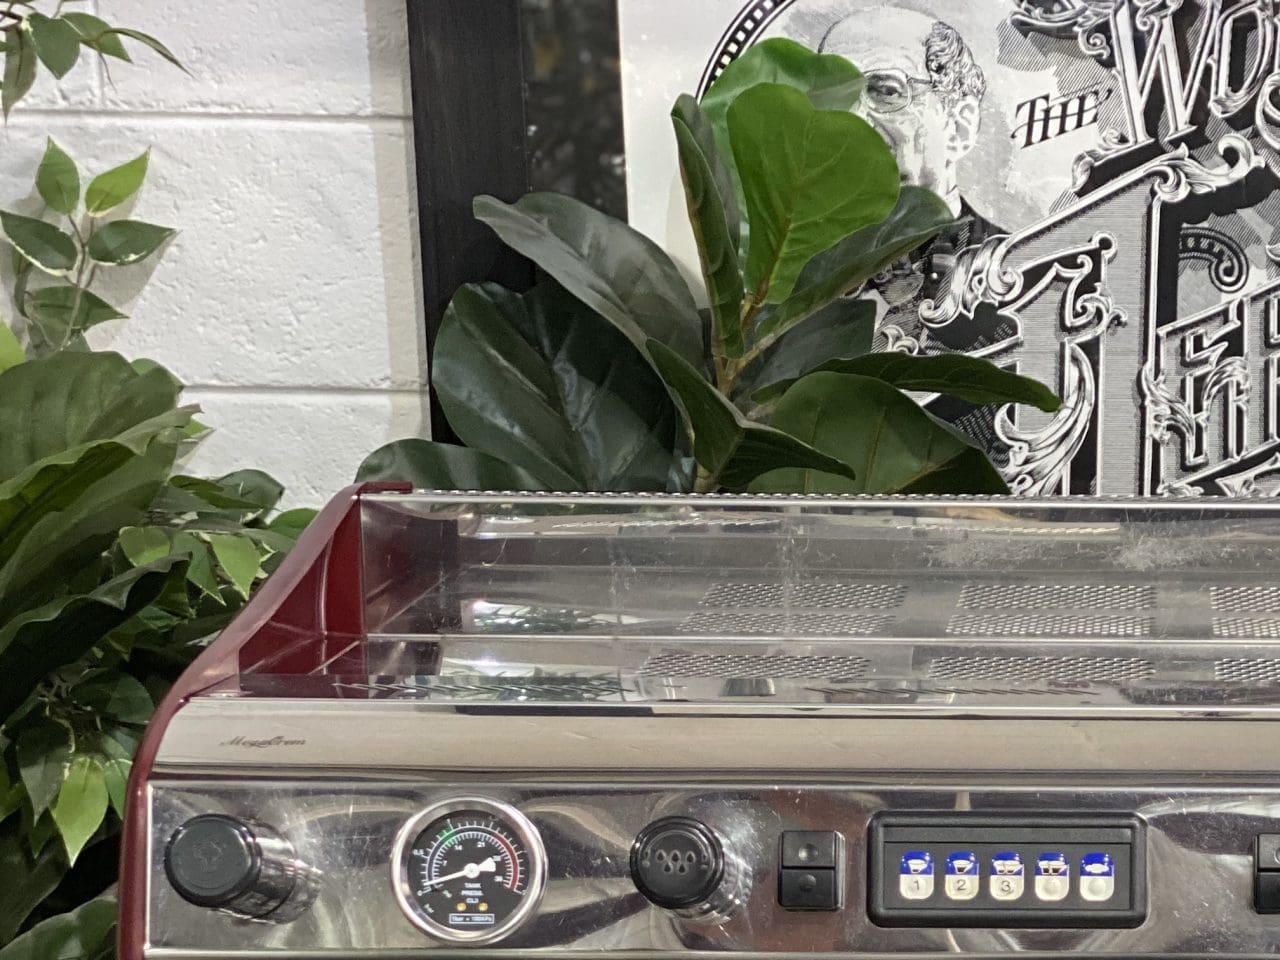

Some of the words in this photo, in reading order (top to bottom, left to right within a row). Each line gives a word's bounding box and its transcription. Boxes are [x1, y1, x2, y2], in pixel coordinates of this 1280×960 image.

[1011, 86, 1112, 149] THE
[913, 880, 920, 891] 1
[956, 879, 966, 891] 2
[1001, 880, 1011, 892] 3
